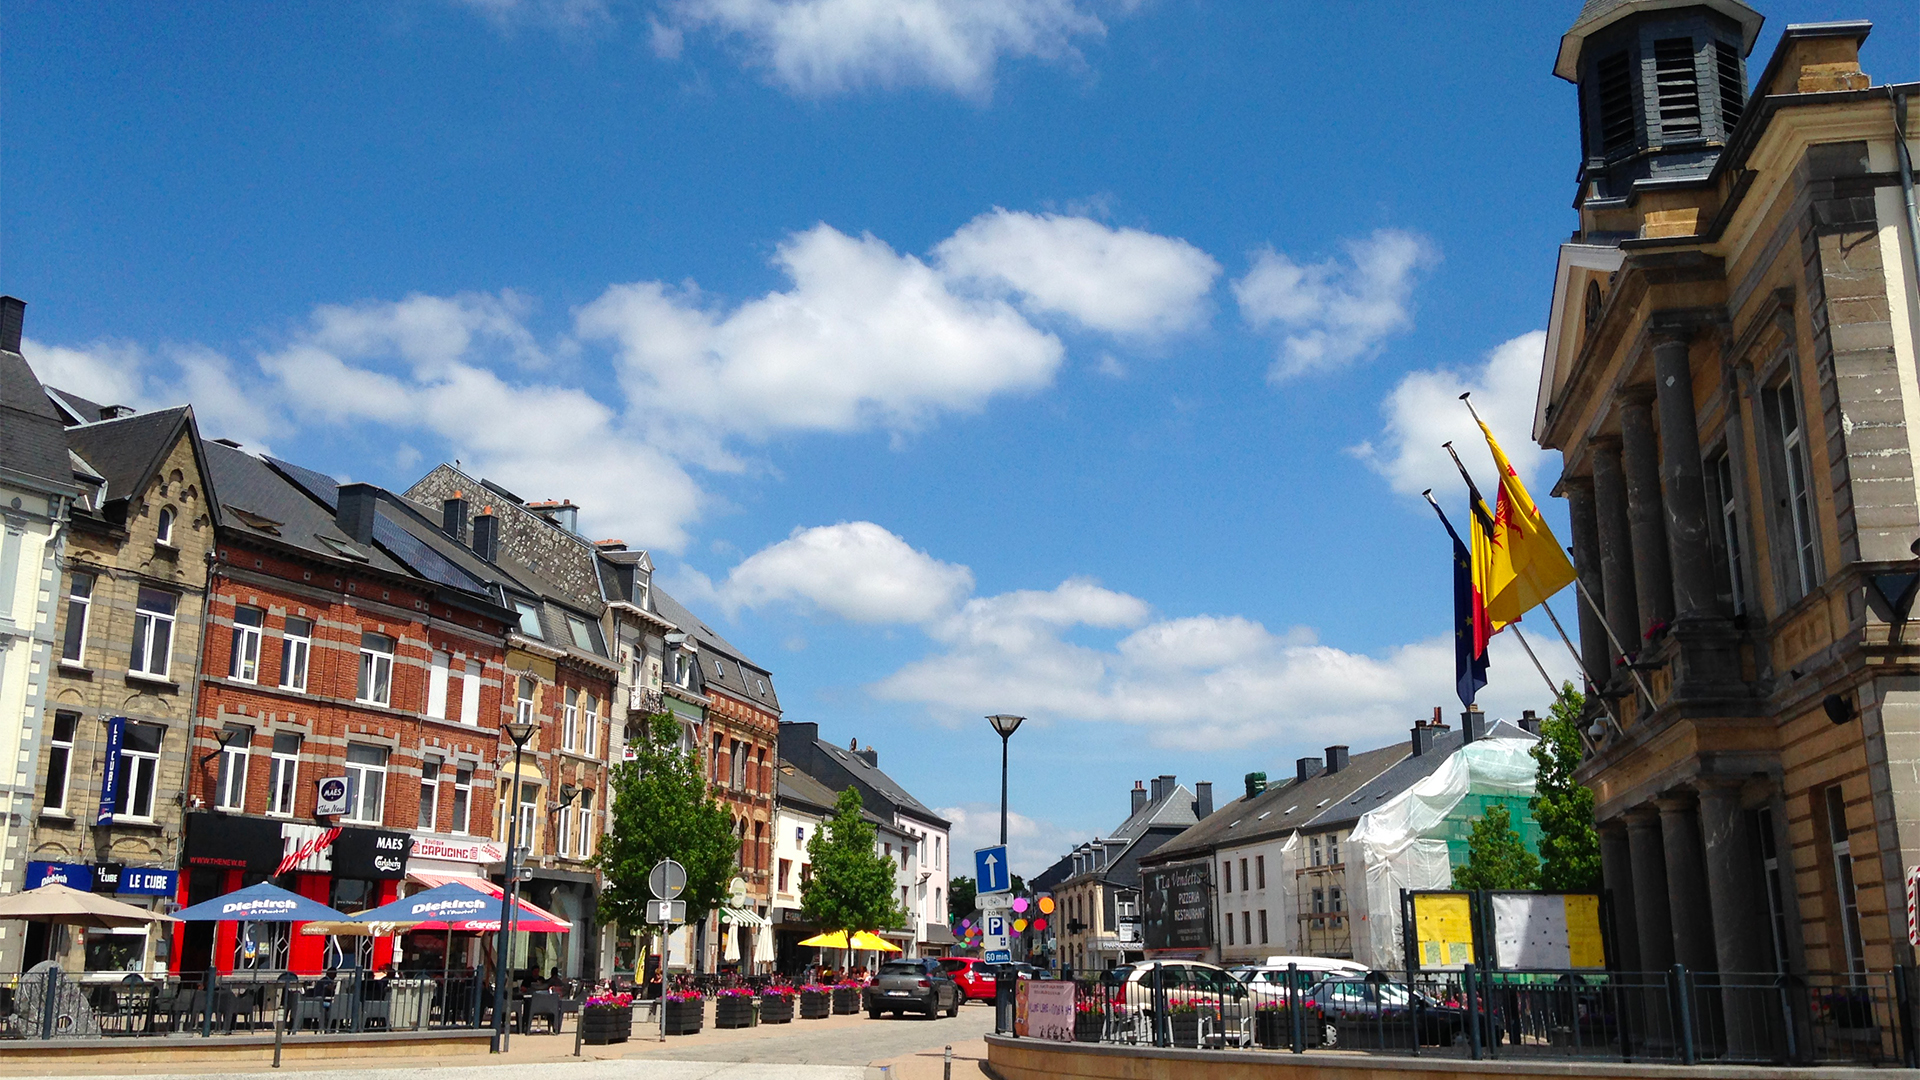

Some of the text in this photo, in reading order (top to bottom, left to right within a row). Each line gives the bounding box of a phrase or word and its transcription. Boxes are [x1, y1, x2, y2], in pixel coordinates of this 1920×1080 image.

[107, 724, 118, 792] LE CUBE
[323, 788, 342, 797] MAES
[376, 836, 404, 850] MAES
[421, 845, 469, 859] CAPUCINE
[374, 855, 402, 871] Carlsberg
[97, 867, 106, 876] LE
[100, 874, 118, 883] CUBE
[129, 874, 168, 890] LE CUBE
[1178, 891, 1200, 905] PIZZERIA
[222, 899, 298, 914] Diekirch
[411, 899, 486, 915] Diekirch
[1174, 907, 1206, 921] RESTAURANT
[990, 918, 1001, 935] P
[986, 952, 995, 962] 60
